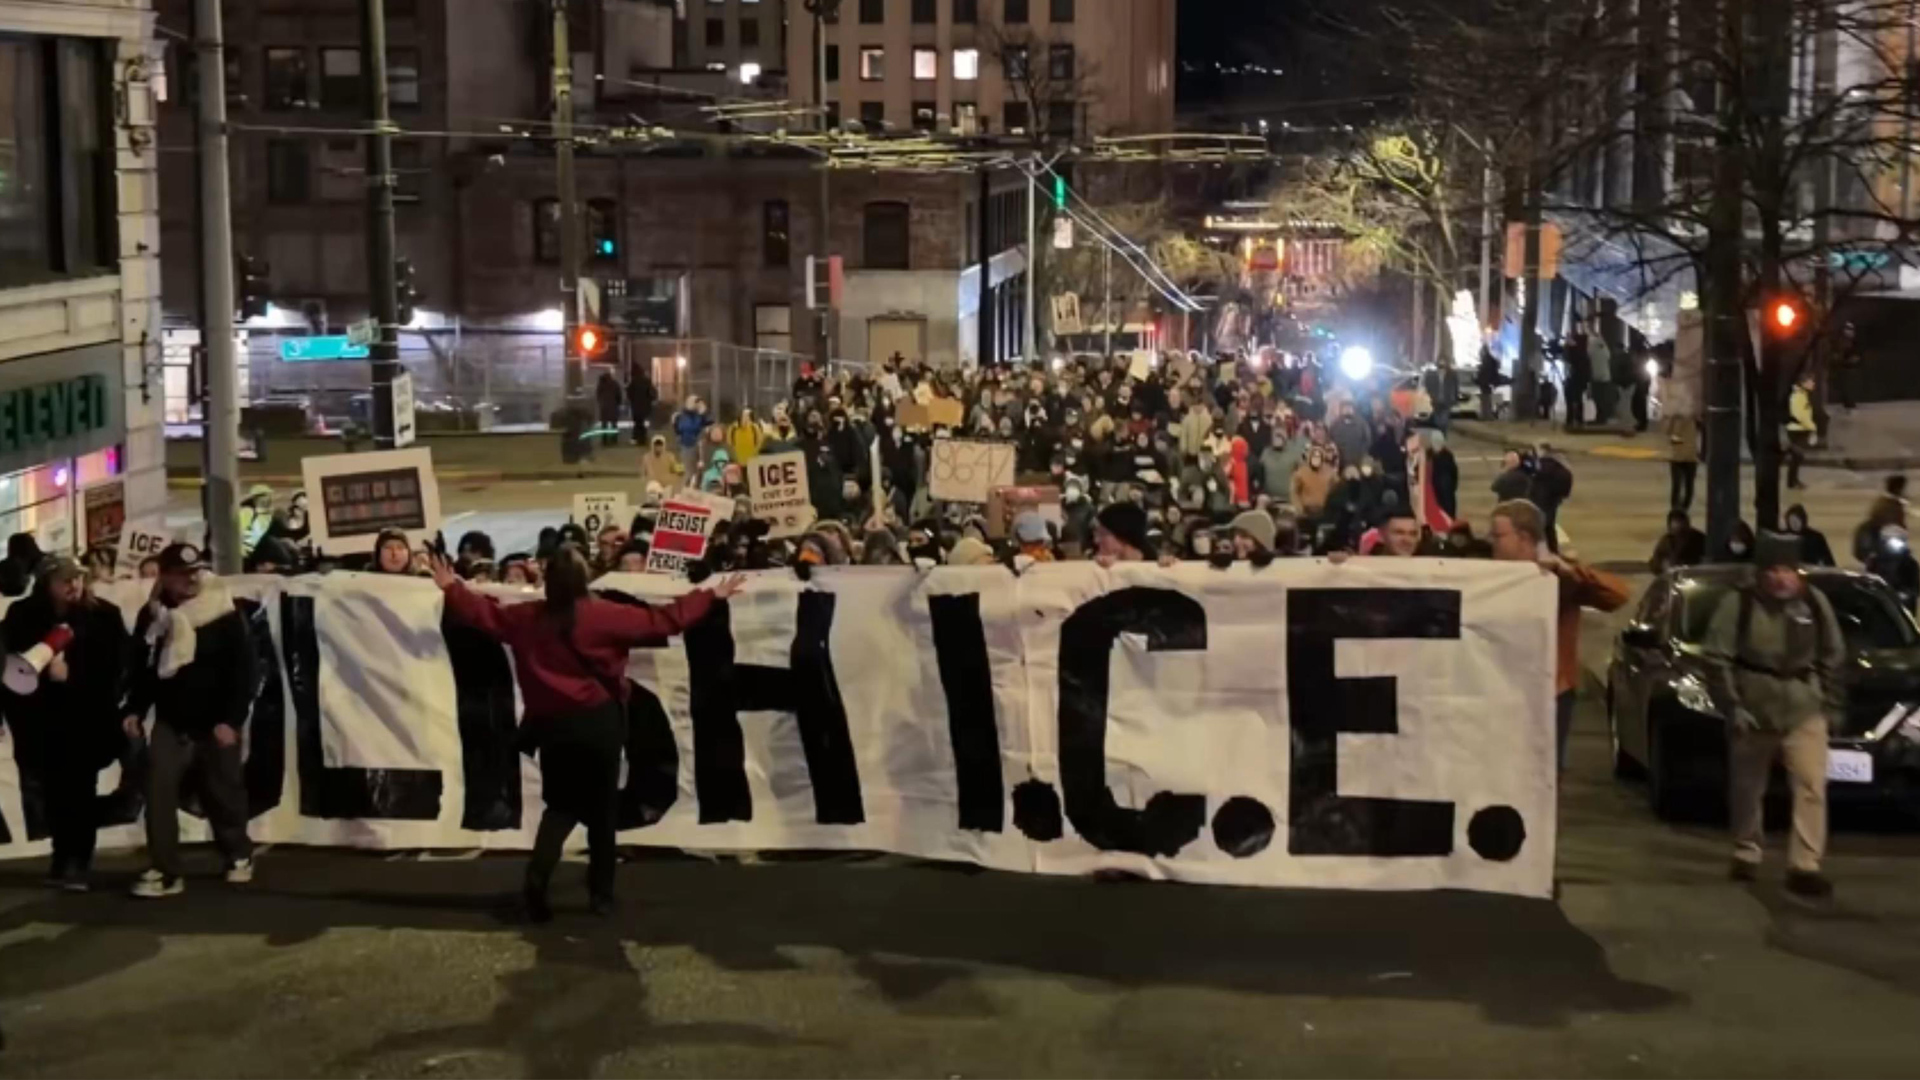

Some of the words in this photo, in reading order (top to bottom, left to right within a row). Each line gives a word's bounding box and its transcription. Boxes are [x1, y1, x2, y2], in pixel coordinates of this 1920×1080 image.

[759, 461, 798, 488] ICE
[658, 510, 708, 534] RESIST
[129, 531, 163, 555] ICE
[928, 586, 1526, 861] I.C.E.
